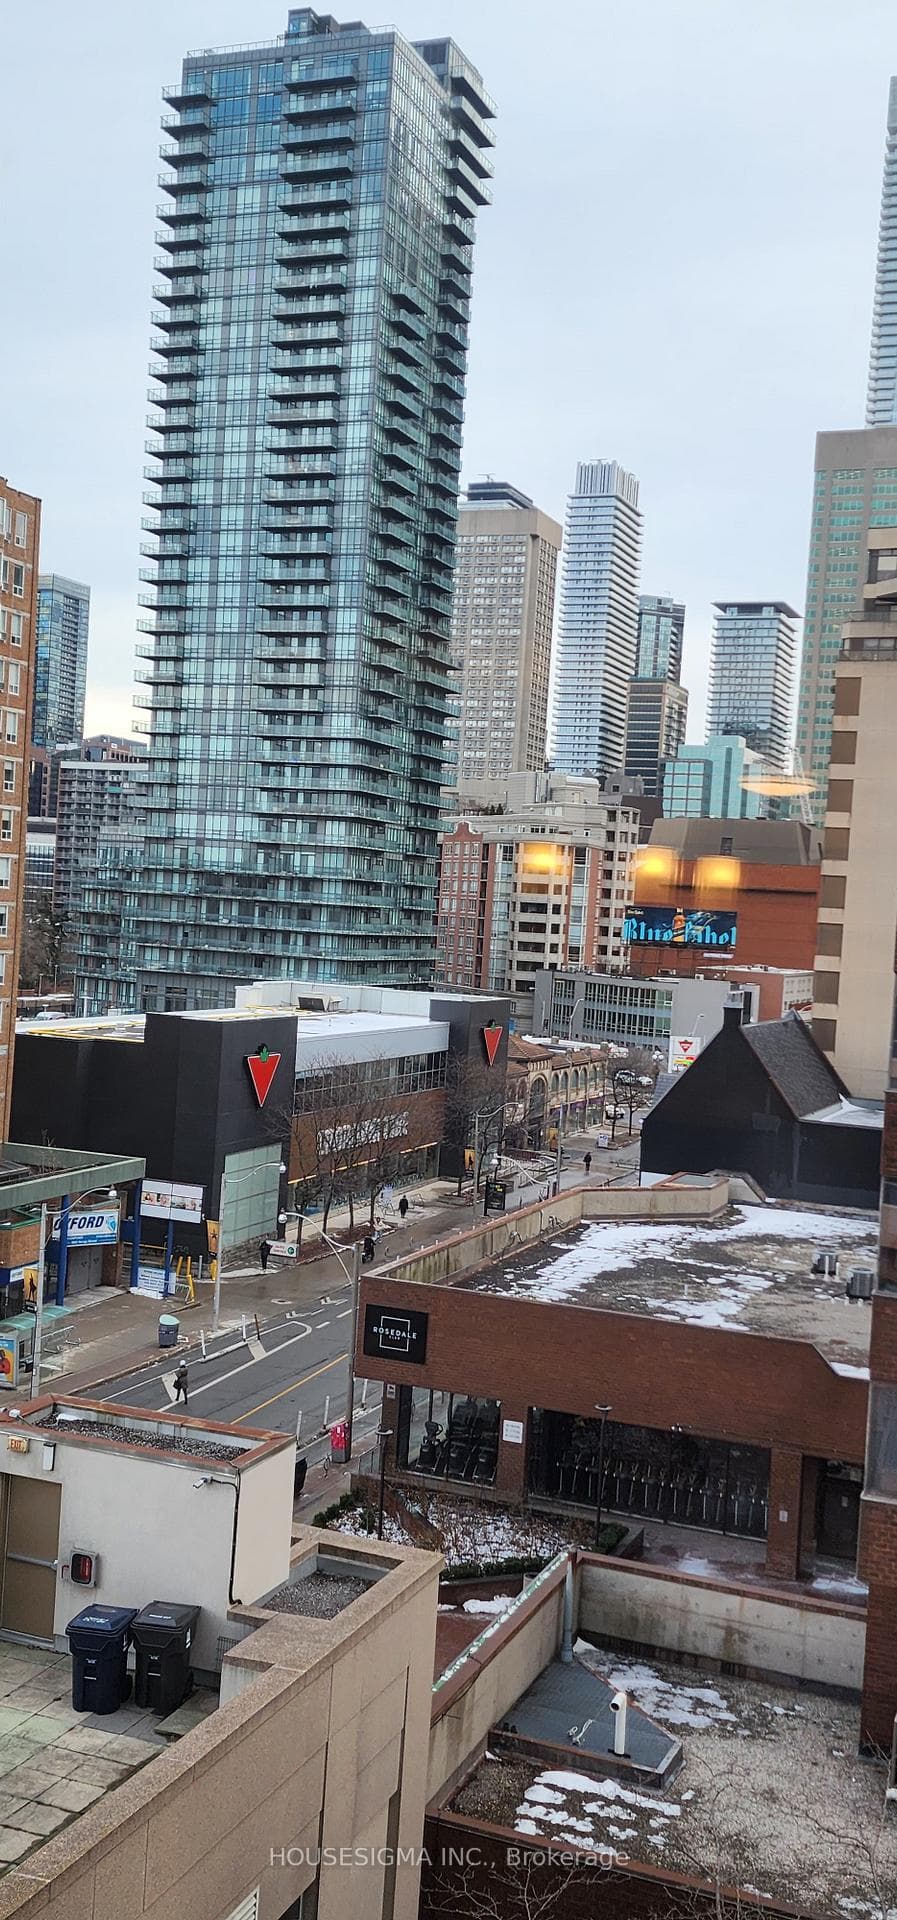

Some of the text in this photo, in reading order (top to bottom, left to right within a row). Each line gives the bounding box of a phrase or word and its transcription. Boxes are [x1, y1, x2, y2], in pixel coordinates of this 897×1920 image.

[624, 918, 673, 944] Blue
[54, 1215, 105, 1231] OFORD
[373, 1326, 417, 1340] ROSEDALE
